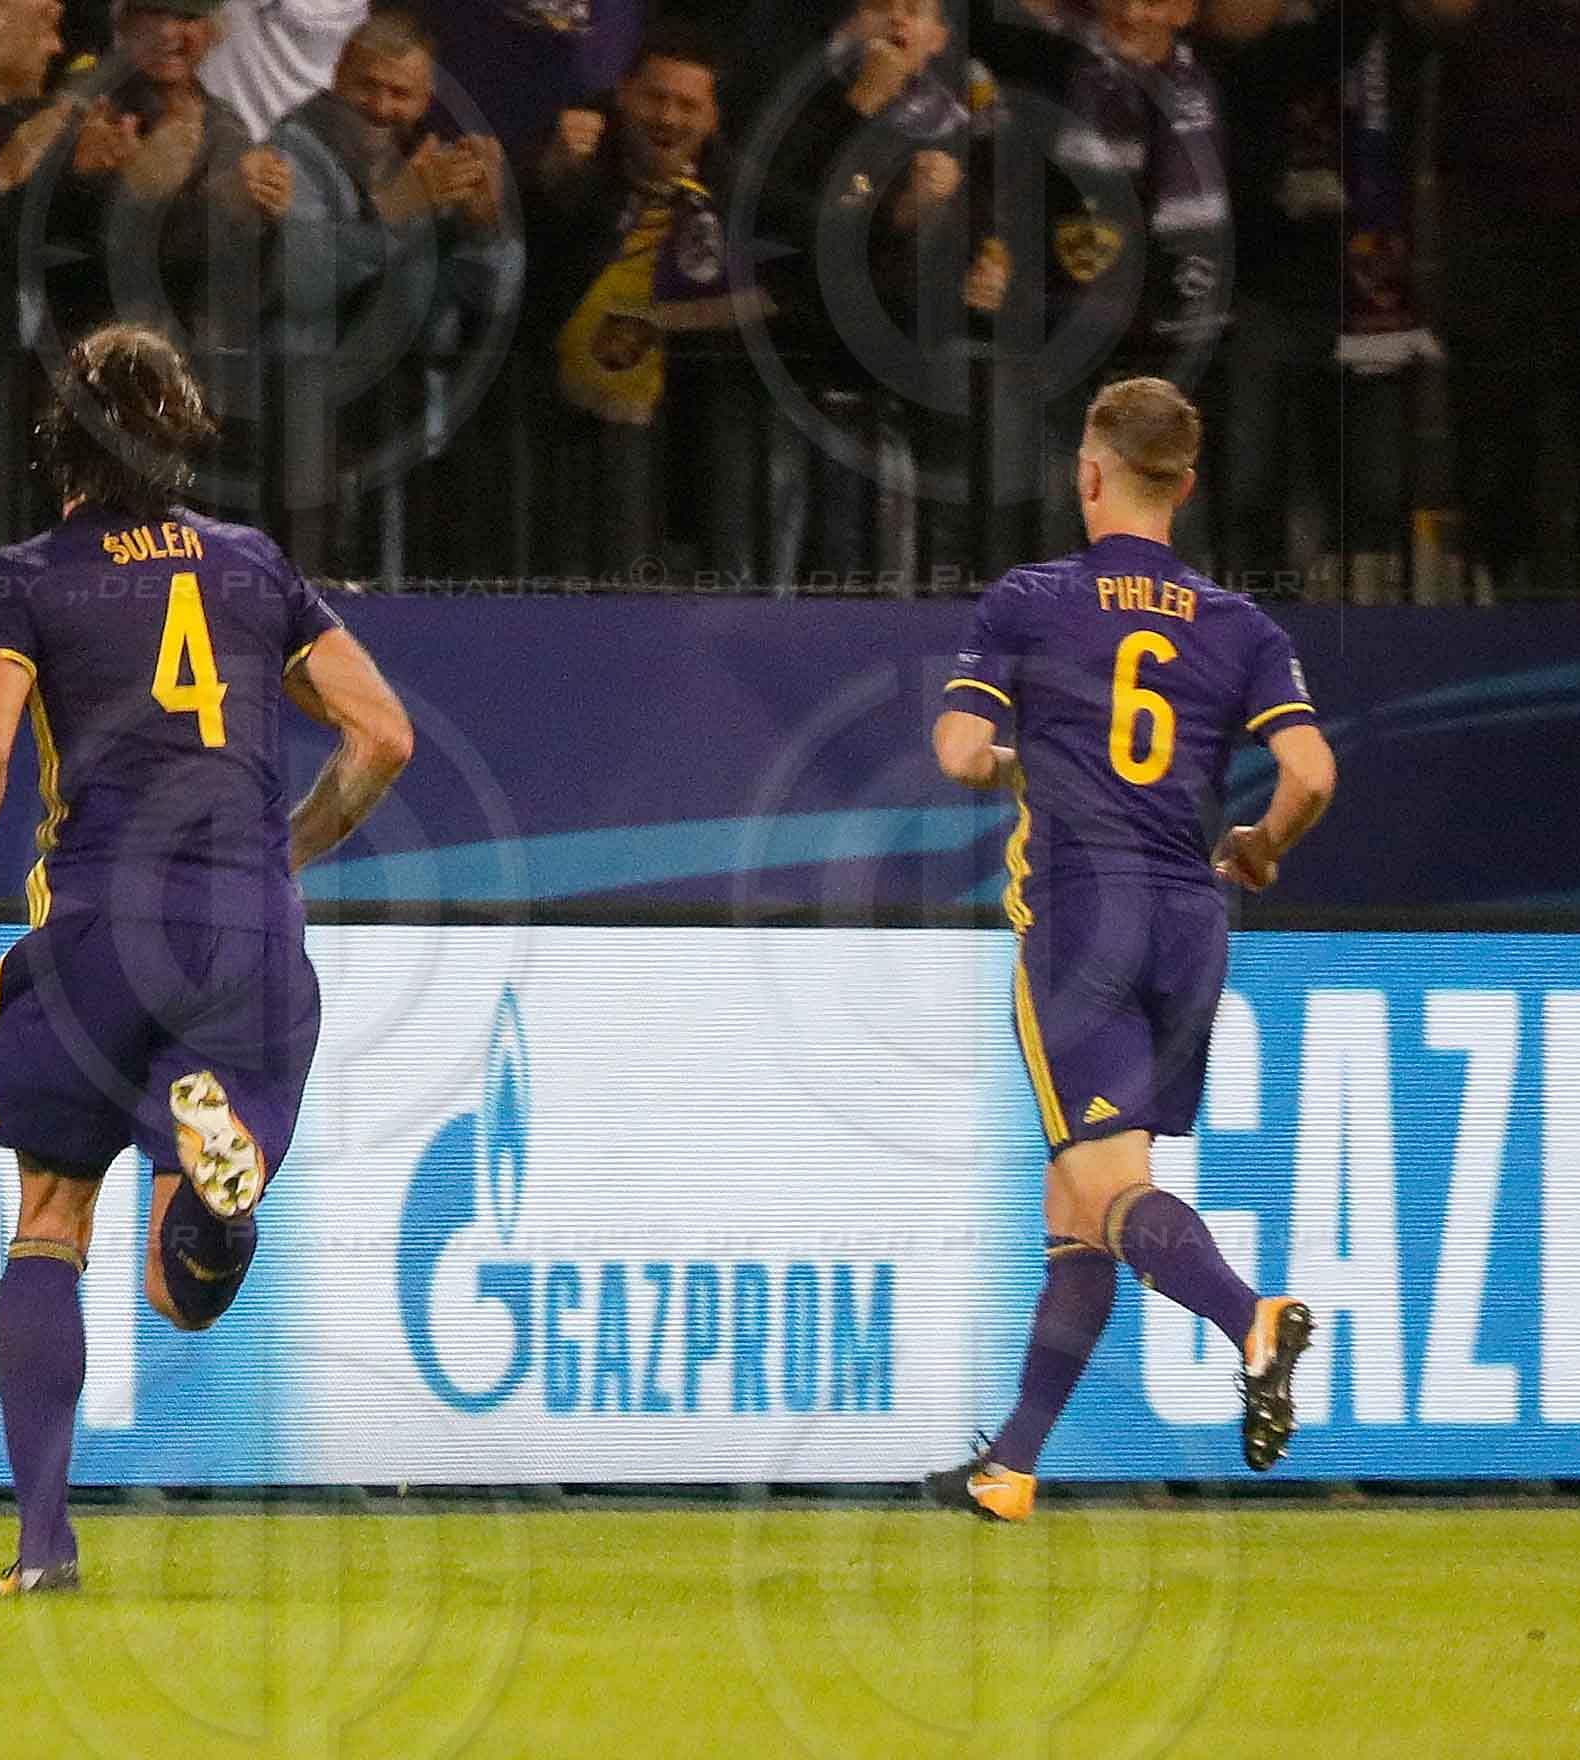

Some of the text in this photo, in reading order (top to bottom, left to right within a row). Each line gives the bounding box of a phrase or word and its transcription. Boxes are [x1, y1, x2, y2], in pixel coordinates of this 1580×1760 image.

[150, 571, 229, 749] 4
[1095, 575, 1198, 624] PIHLER
[1108, 630, 1179, 786] 6
[542, 1260, 896, 1414] GAZPROM
